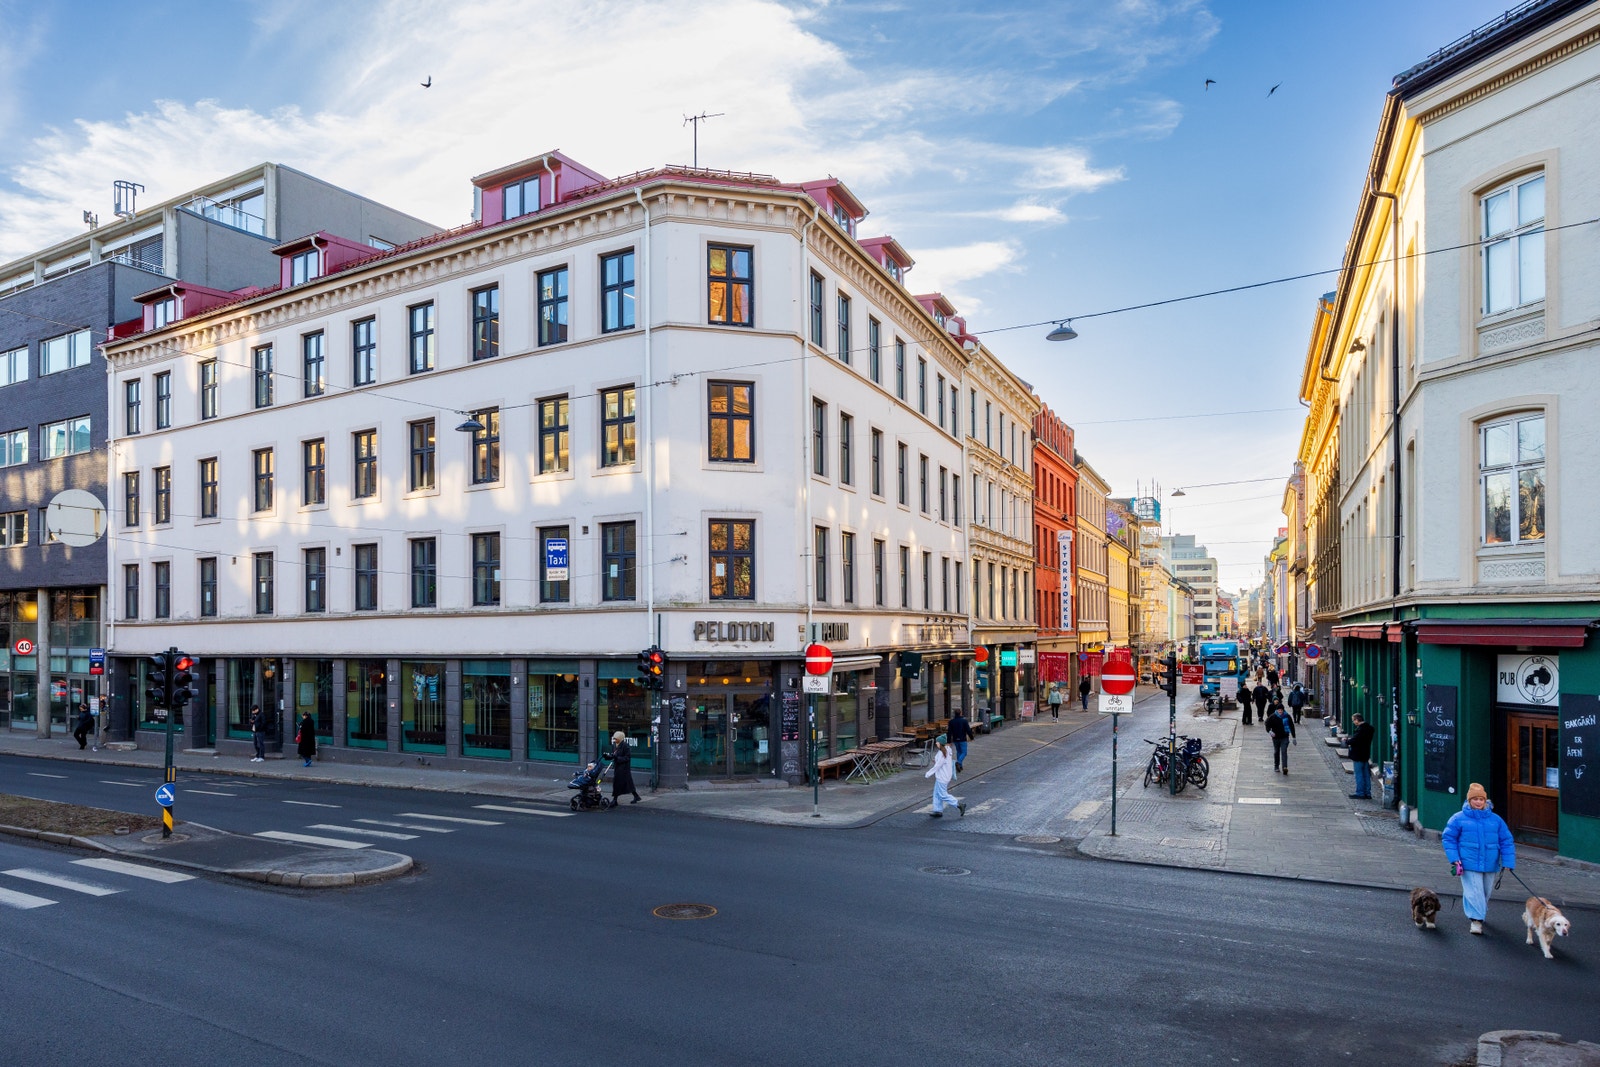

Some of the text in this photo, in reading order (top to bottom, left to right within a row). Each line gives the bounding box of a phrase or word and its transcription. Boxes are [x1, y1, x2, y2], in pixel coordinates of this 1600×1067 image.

[548, 554, 567, 565] Taxi
[694, 621, 774, 641] PELOTON
[822, 622, 849, 641] PELOTON
[1500, 672, 1515, 685] PUB
[1567, 746, 1582, 757] ÅPEN
